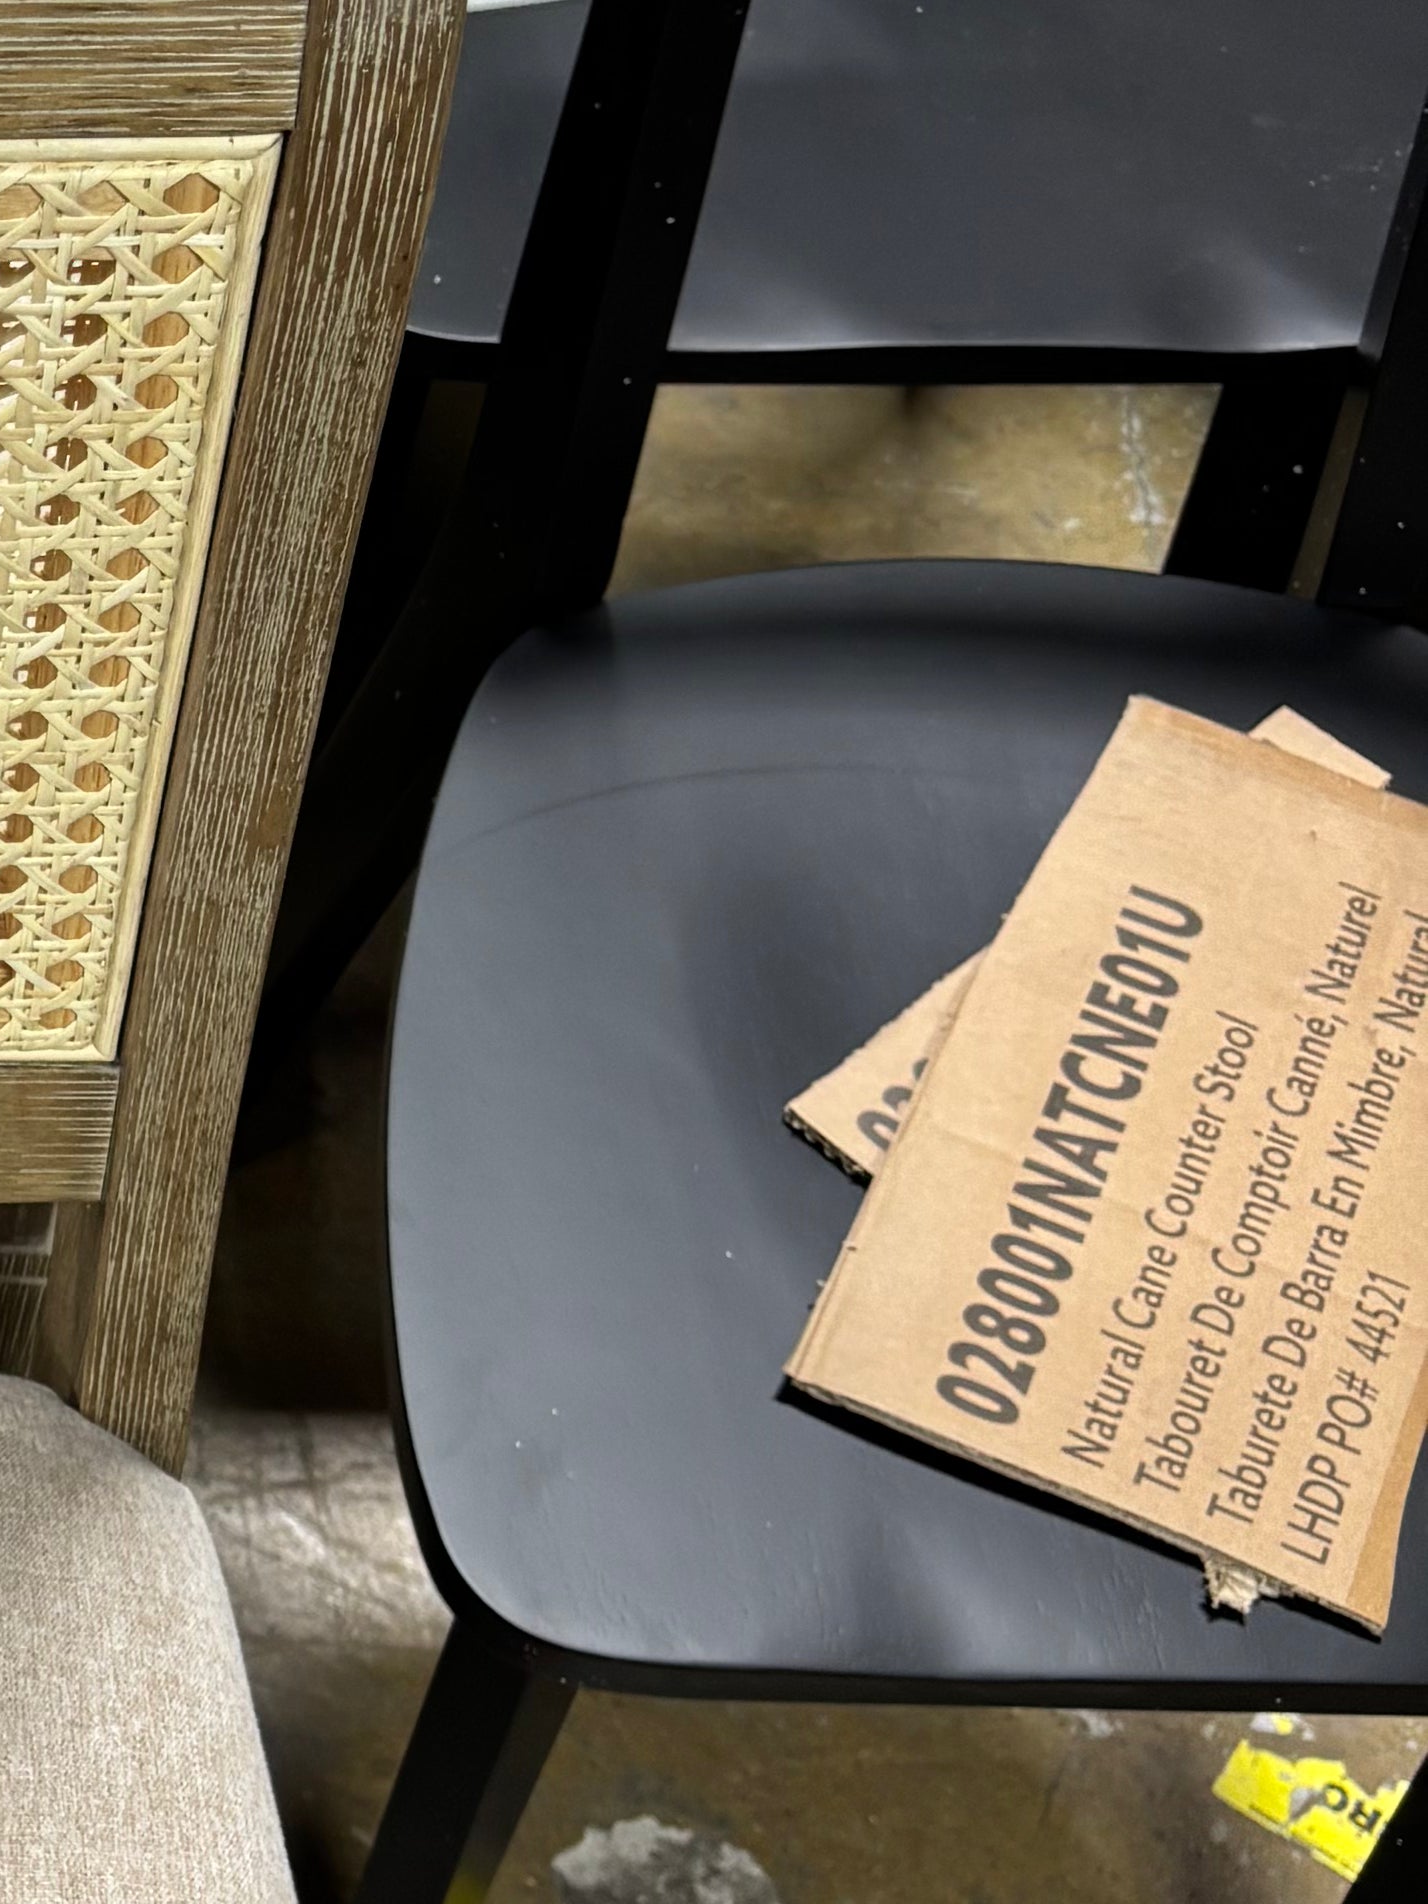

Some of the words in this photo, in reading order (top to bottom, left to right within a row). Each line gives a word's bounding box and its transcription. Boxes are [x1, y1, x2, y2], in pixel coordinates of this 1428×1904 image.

[1305, 881, 1382, 1005] Naturel
[1373, 909, 1428, 1033] Natural
[1193, 1010, 1259, 1102] Stool
[1266, 1013, 1349, 1117] Canné,
[1327, 1046, 1416, 1172] Mimbre,
[935, 884, 1205, 1426] 028001NATCNE01U
[1144, 1103, 1227, 1238] Counter
[1212, 1120, 1300, 1278] Comptoir
[1311, 1175, 1365, 1219] En
[1112, 1245, 1177, 1330] Cane
[1190, 1285, 1245, 1336] De
[1280, 1223, 1349, 1313] Barra
[1346, 1269, 1411, 1364] 44521
[1060, 1329, 1146, 1469] Natural
[1261, 1317, 1317, 1369] De
[1133, 1338, 1227, 1493] Tabouret
[1206, 1372, 1298, 1524] Taburete
[1316, 1367, 1379, 1455] PO#
[1281, 1453, 1351, 1565] LHDP
